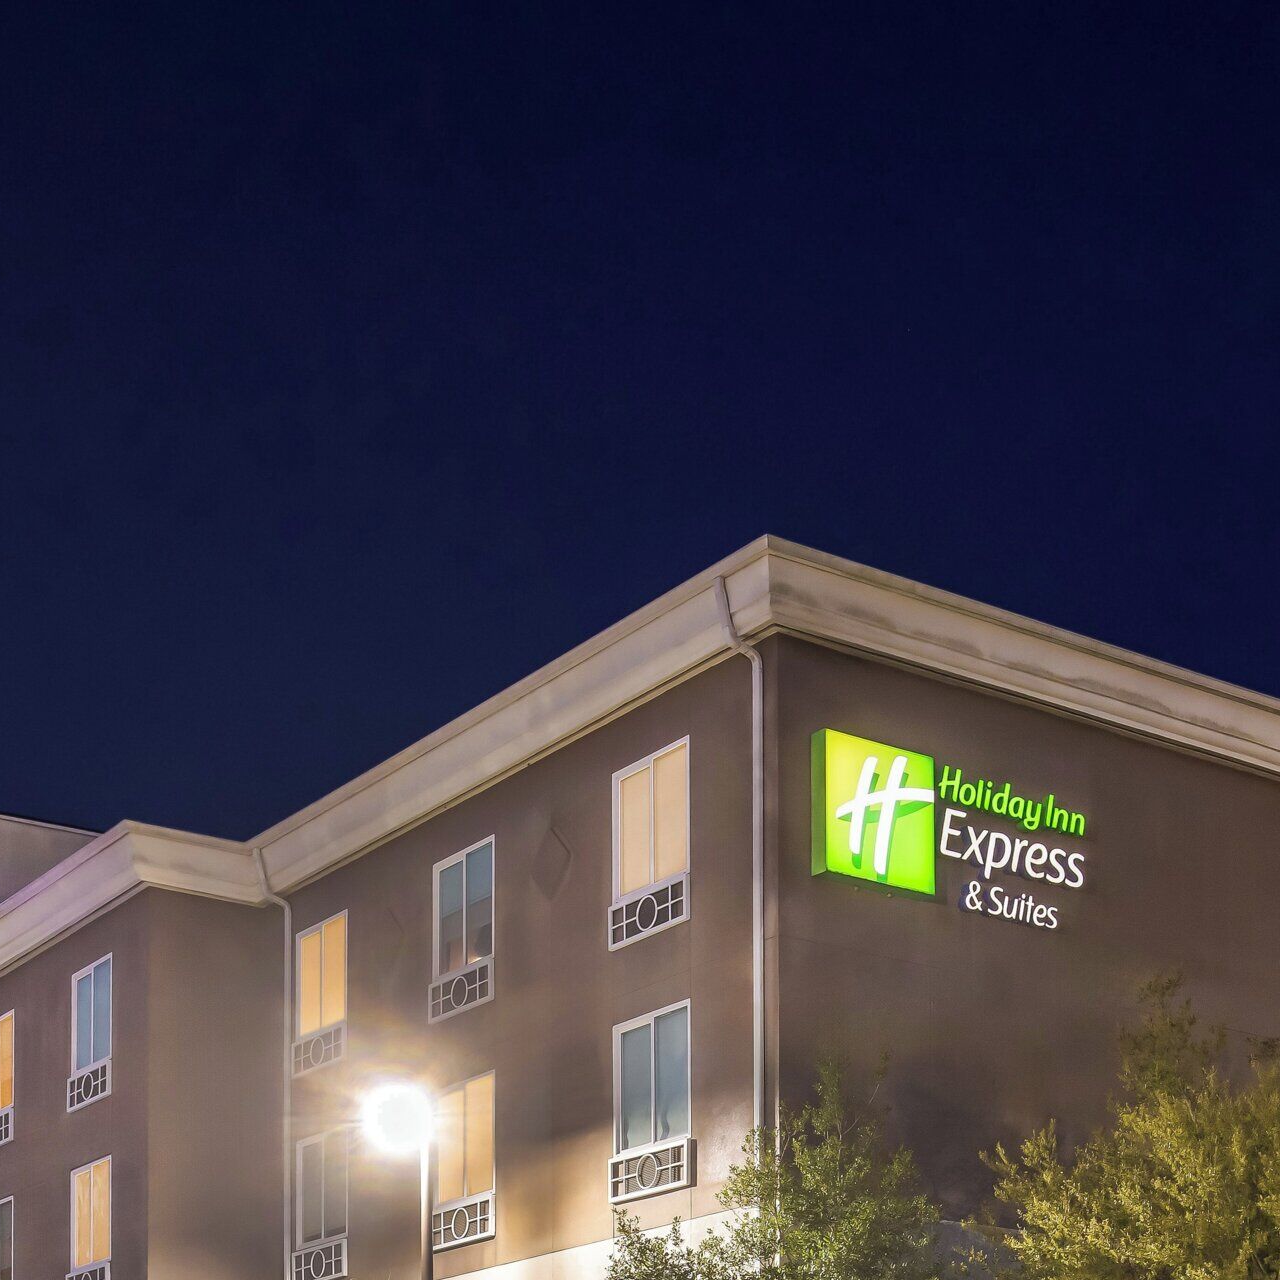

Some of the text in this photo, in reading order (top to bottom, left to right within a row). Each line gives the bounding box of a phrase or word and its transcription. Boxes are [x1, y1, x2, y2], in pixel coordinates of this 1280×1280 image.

[938, 764, 1086, 836] Holiday Inn
[939, 807, 1085, 888] Express
[965, 880, 1058, 929] & Suites
